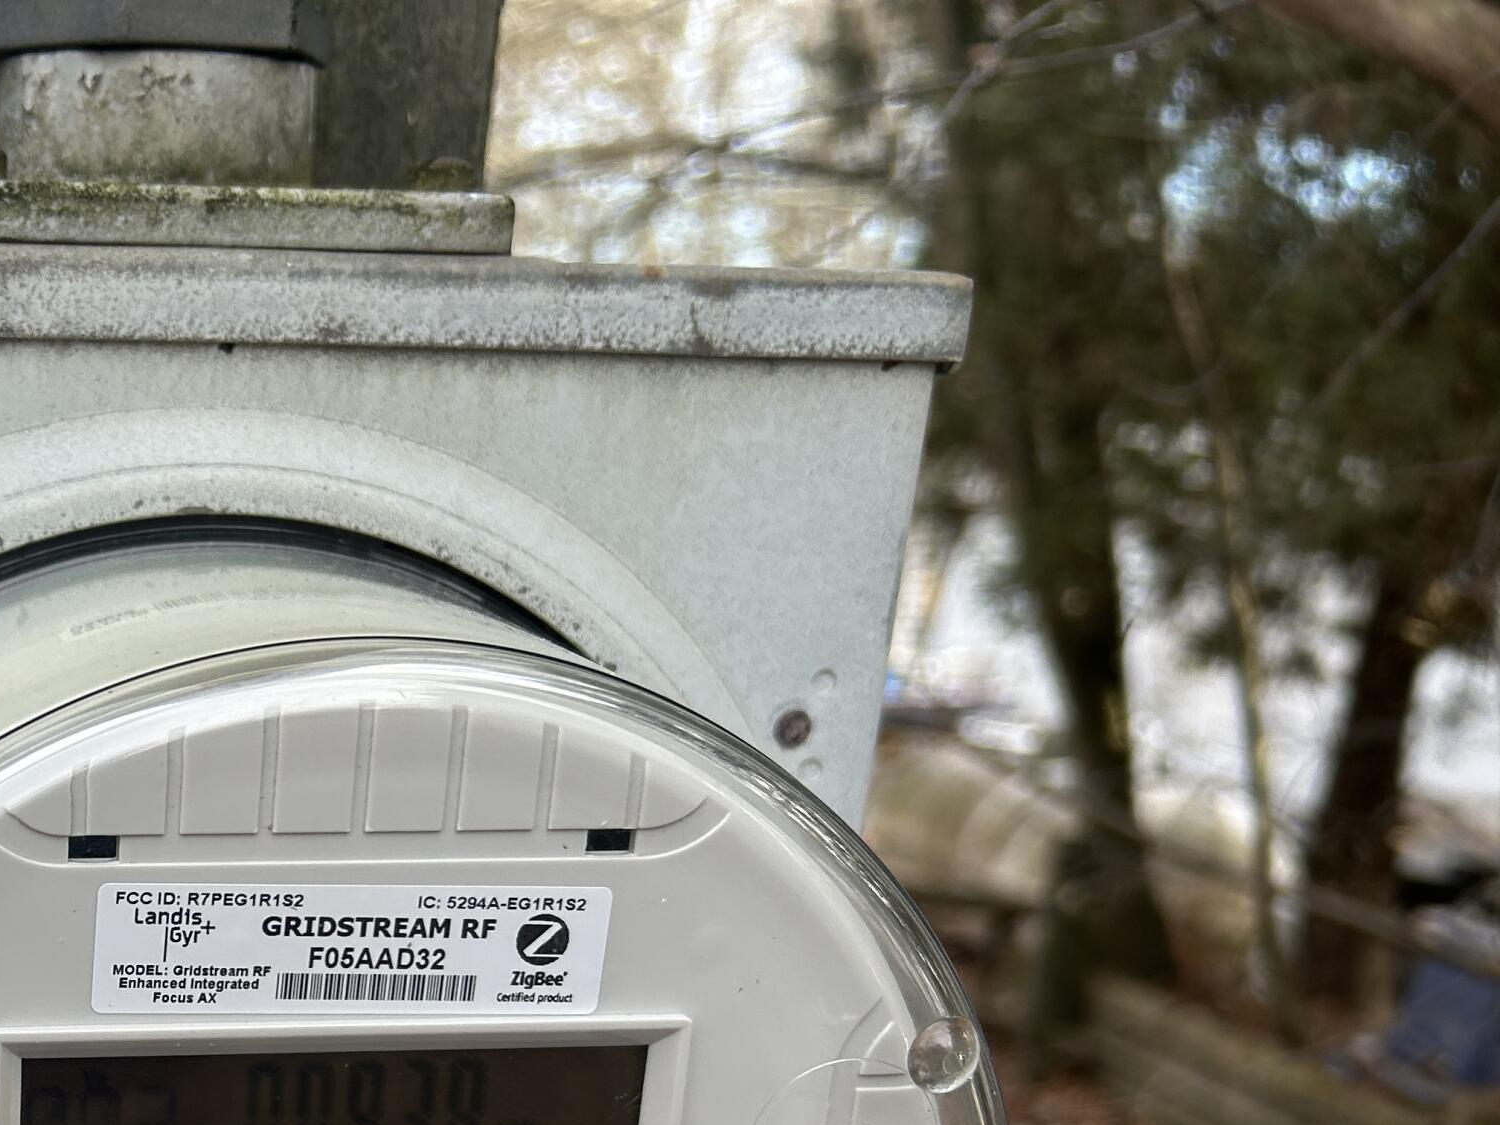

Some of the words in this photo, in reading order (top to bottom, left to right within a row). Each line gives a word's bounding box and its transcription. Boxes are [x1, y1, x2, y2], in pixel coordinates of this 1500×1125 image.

[115, 891, 153, 905] FCC
[157, 892, 181, 906] ID:
[187, 892, 305, 908] R7PEG1R1S2
[417, 896, 442, 909] IC:
[446, 896, 588, 911] 5294A-EG1R1S2
[261, 915, 452, 939] GRIDSTREAM
[460, 918, 498, 939] RF
[169, 926, 201, 948] Gyr
[307, 946, 447, 970] F05AAD32
[112, 964, 169, 977] MODEL:
[173, 965, 250, 978] Gridstream
[252, 965, 272, 977] RF
[118, 977, 187, 990] Enhanced
[190, 978, 260, 992] Integrated
[510, 971, 568, 990] ZigBee
[152, 992, 194, 1004] Focus
[197, 992, 218, 1004] AX
[496, 991, 536, 1004] Certified
[537, 992, 573, 1005] product
